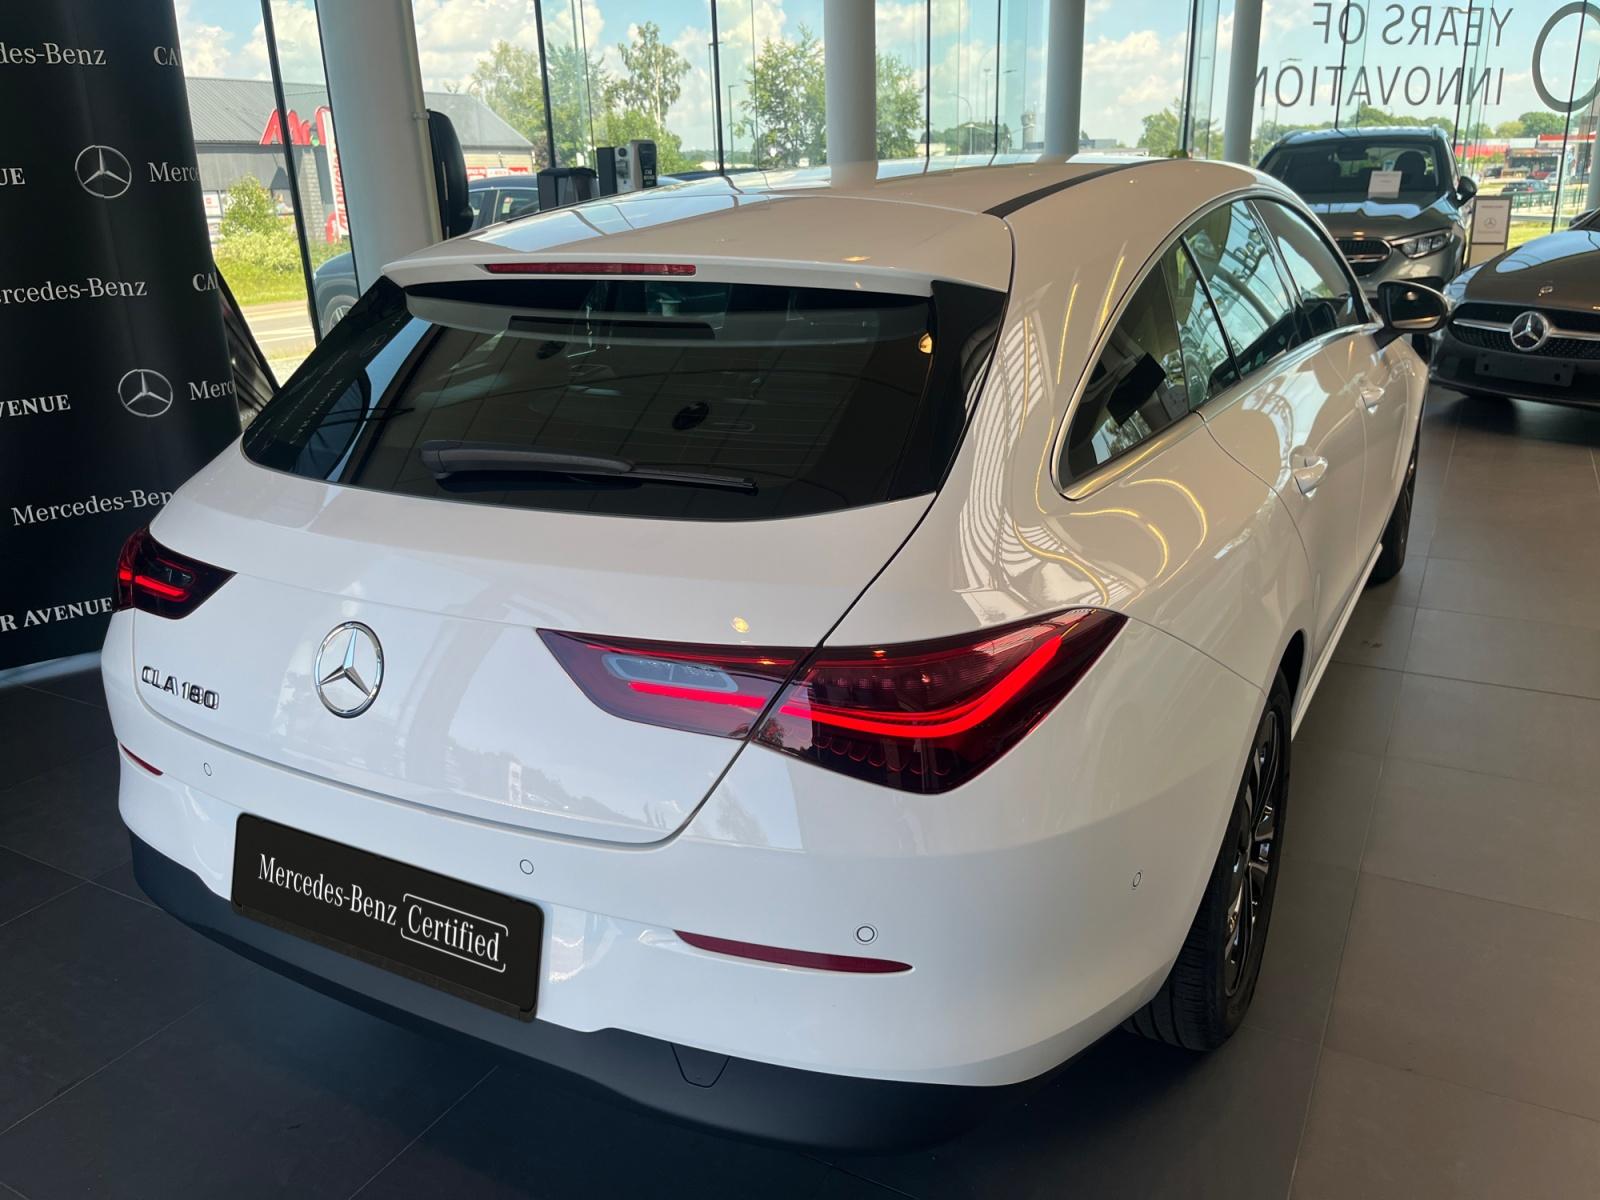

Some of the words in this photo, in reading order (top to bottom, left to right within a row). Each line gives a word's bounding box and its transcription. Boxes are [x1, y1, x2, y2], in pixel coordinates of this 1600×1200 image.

[153, 46, 181, 67] CA
[0, 277, 148, 304] rcedes-Benz
[23, 597, 113, 628] AVENUE
[141, 665, 179, 696] CLA
[182, 682, 219, 710] 180
[258, 854, 397, 926] Mercedes-Benz
[407, 904, 500, 962] Certified
